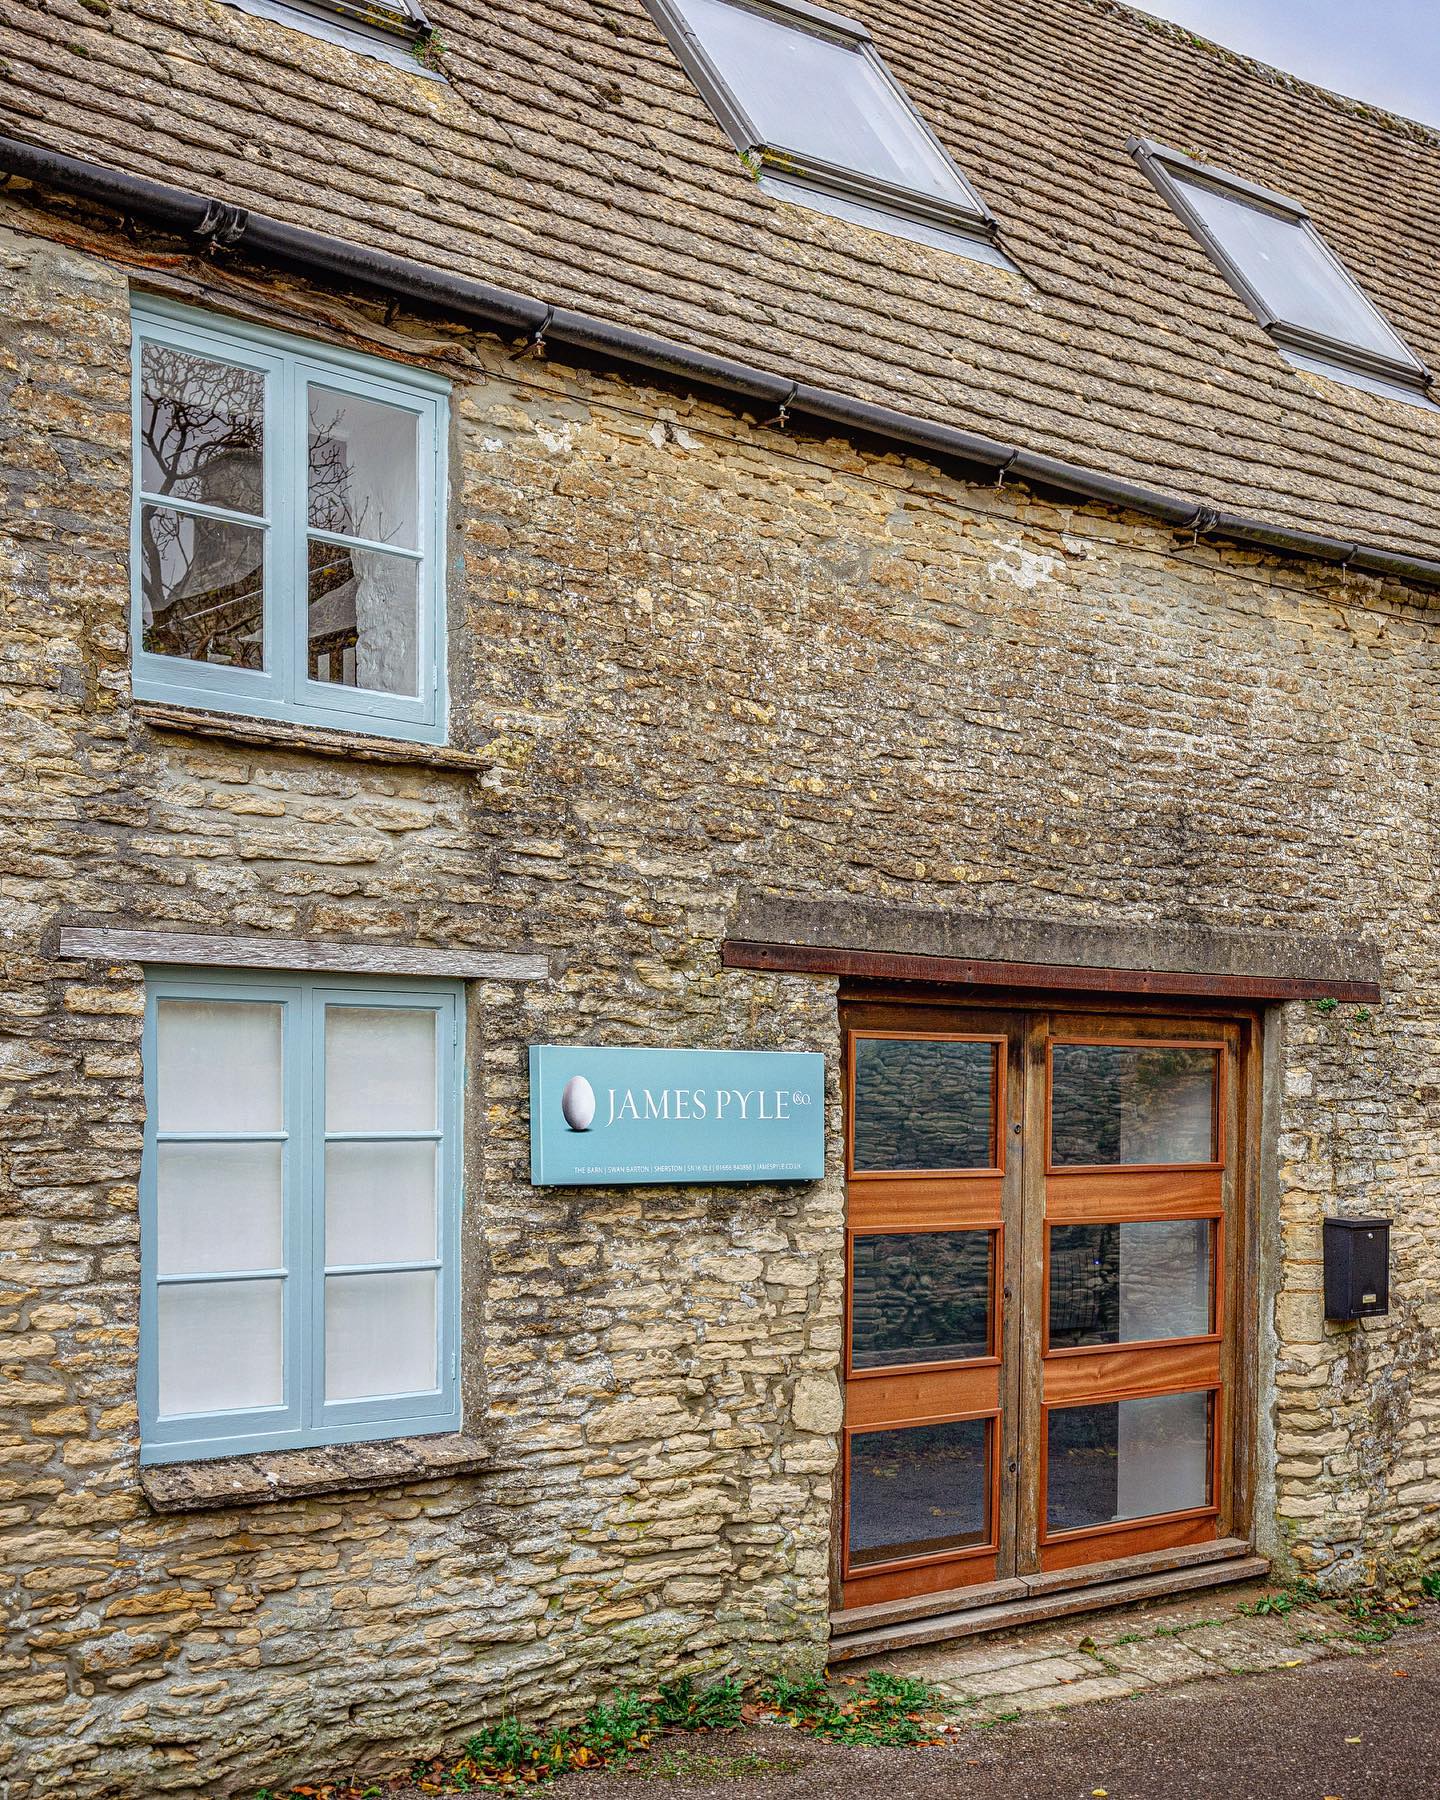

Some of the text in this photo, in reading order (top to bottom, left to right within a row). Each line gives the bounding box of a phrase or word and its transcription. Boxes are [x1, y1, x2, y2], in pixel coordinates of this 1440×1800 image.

[604, 1088, 707, 1128] JAMES
[715, 1089, 791, 1120] PYLE
[607, 1166, 625, 1174] SWAN
